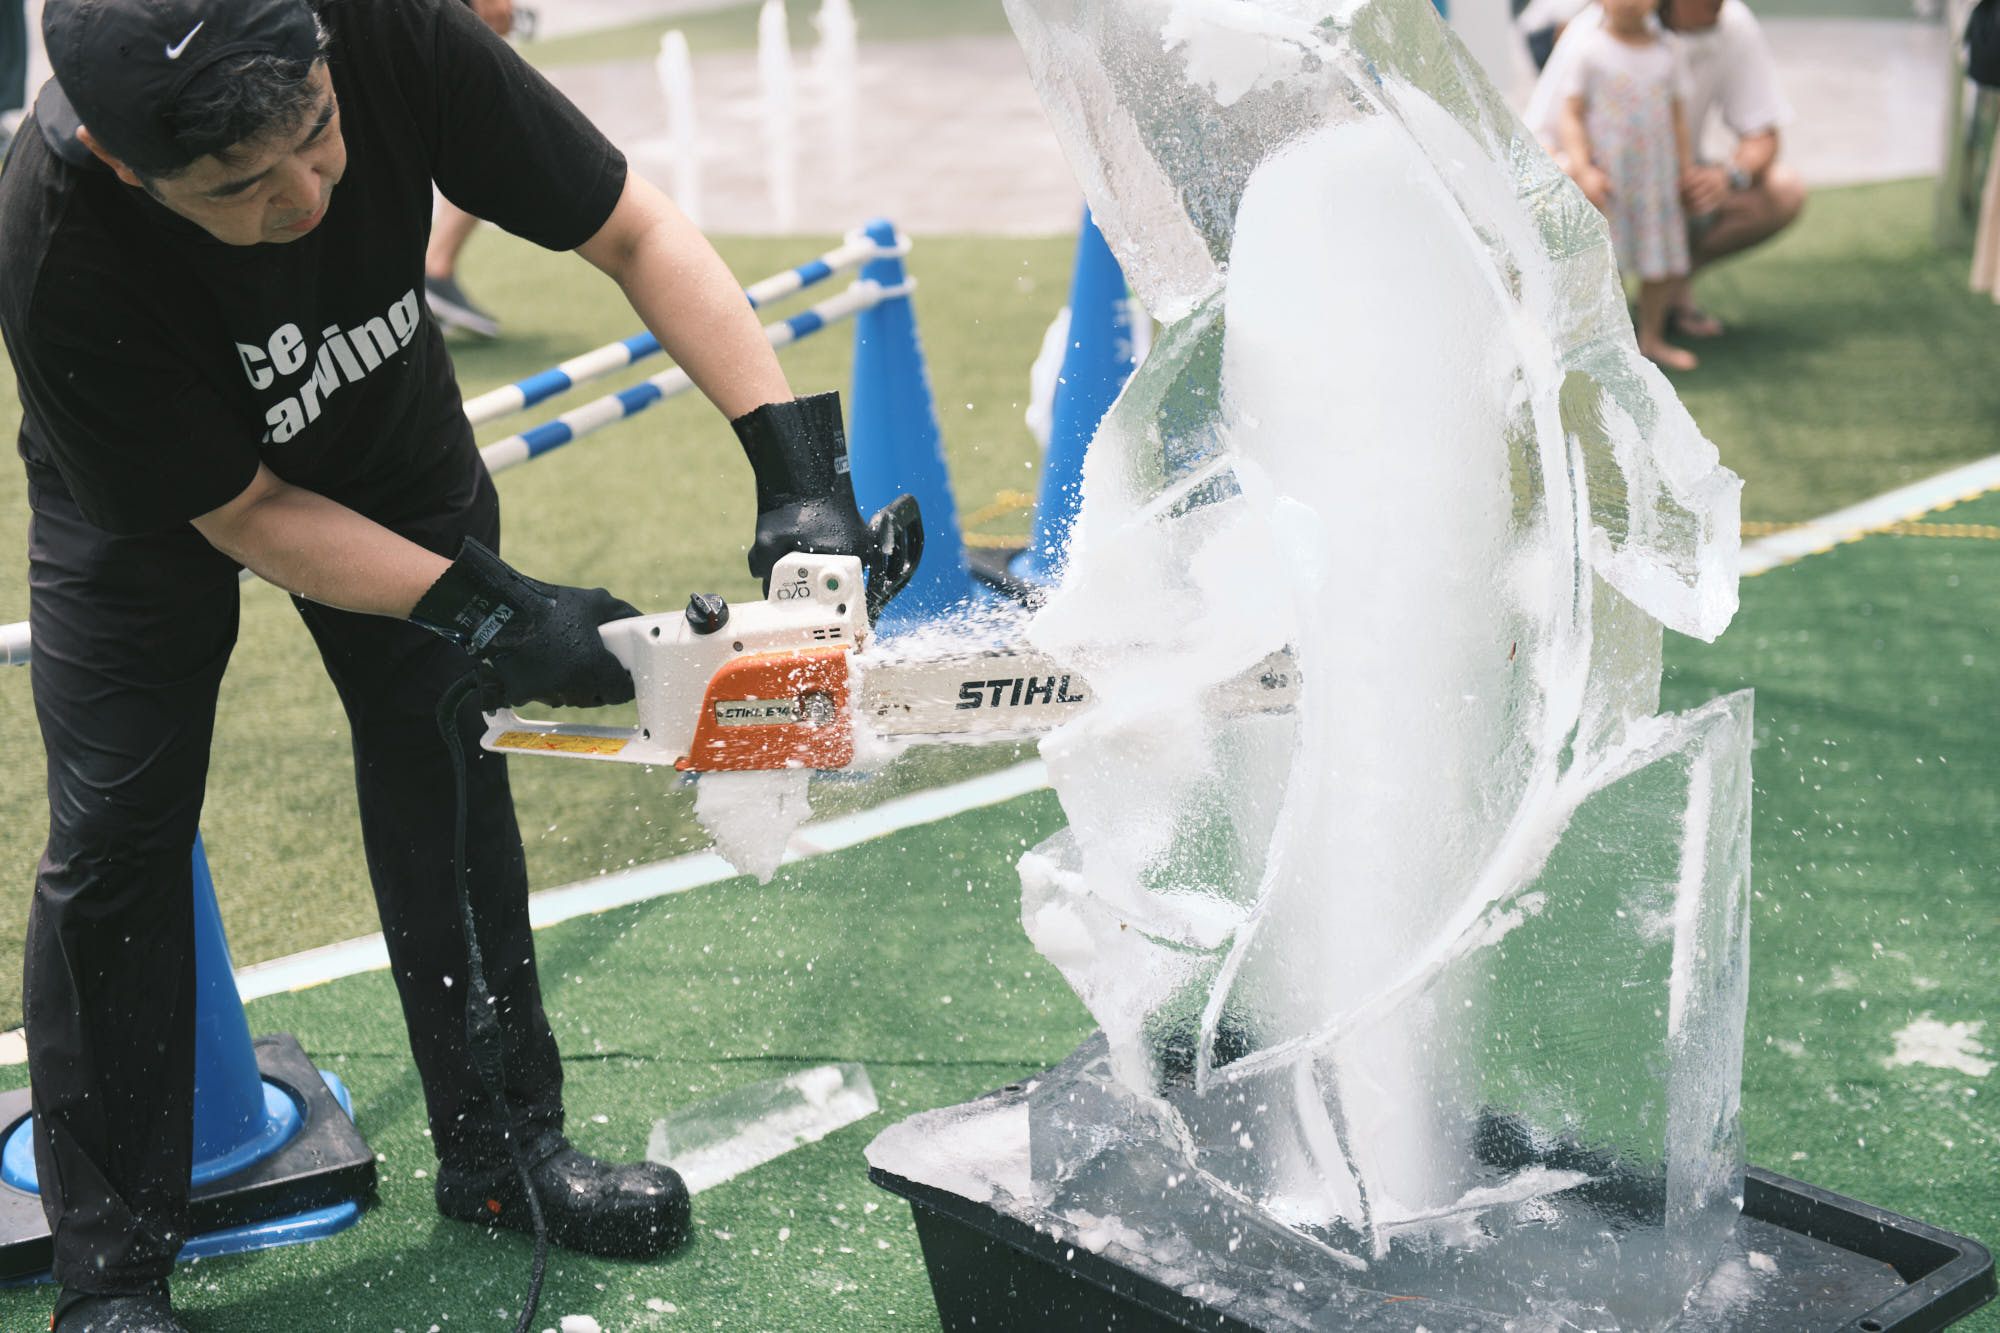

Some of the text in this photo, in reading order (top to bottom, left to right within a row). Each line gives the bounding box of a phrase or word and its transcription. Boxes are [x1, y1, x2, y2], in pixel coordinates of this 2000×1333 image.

[235, 323, 307, 390] ce
[262, 288, 420, 443] arving
[725, 708, 762, 719] STIHL
[956, 675, 1083, 710] STIHL
